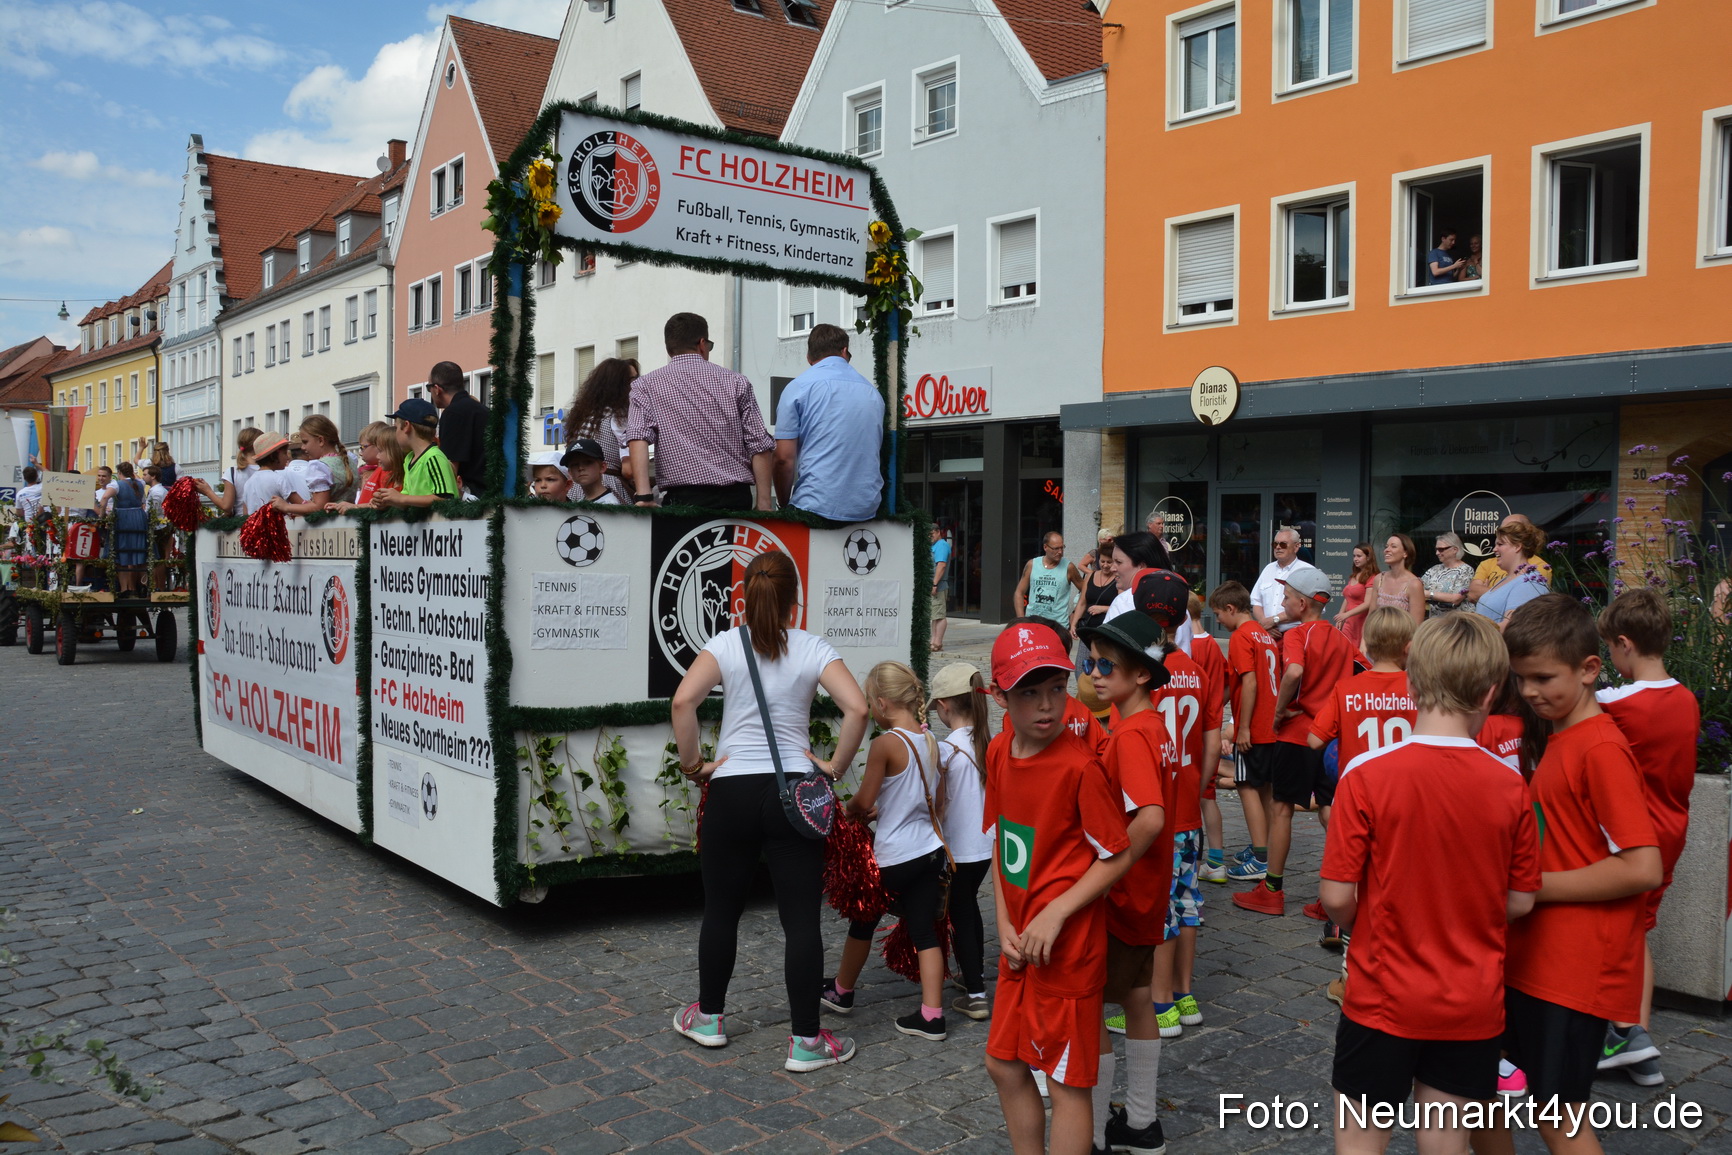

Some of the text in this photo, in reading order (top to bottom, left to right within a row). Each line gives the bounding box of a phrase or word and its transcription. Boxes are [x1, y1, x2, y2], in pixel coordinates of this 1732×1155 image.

[573, 132, 656, 173] HOLZHEIM
[569, 169, 581, 194] F.C.
[679, 145, 854, 201] FC HOLZHEIM
[677, 199, 860, 244] Fußball, Tennis, Gymnastik,
[676, 226, 854, 267] Kraft + Fitness, Kindertanz
[903, 373, 990, 418] s.Oliver
[1200, 382, 1228, 394] Dianas
[1200, 394, 1228, 407] Floristik
[1633, 468, 1647, 480] 30
[1043, 480, 1064, 503] SAL
[1465, 508, 1499, 521] Dianas
[1161, 523, 1184, 533] loristik
[1465, 522, 1499, 535] Floristik
[380, 528, 463, 557] Neuer Markt
[380, 565, 414, 594] Neues
[534, 581, 577, 593] -TENNIS
[660, 525, 773, 656] F.C. HOLZHE
[825, 586, 859, 597] -TENNIS
[225, 568, 243, 608] Am
[273, 570, 313, 617] Kanal
[381, 603, 415, 633] Techn.
[533, 605, 627, 617] -KRAFT & FITNESS
[824, 607, 898, 617] -KRAFT & FITNESS
[533, 627, 600, 639] -GYMNASTIK
[824, 627, 877, 638] -GYMNASTIK
[1010, 651, 1023, 660] Audi
[381, 677, 465, 724] FC Holzheim
[1345, 693, 1362, 713] FC
[213, 671, 342, 765] FC HOLZHEIM
[381, 711, 411, 744] Neues
[1157, 694, 1200, 768] 12
[1357, 716, 1412, 752] 10
